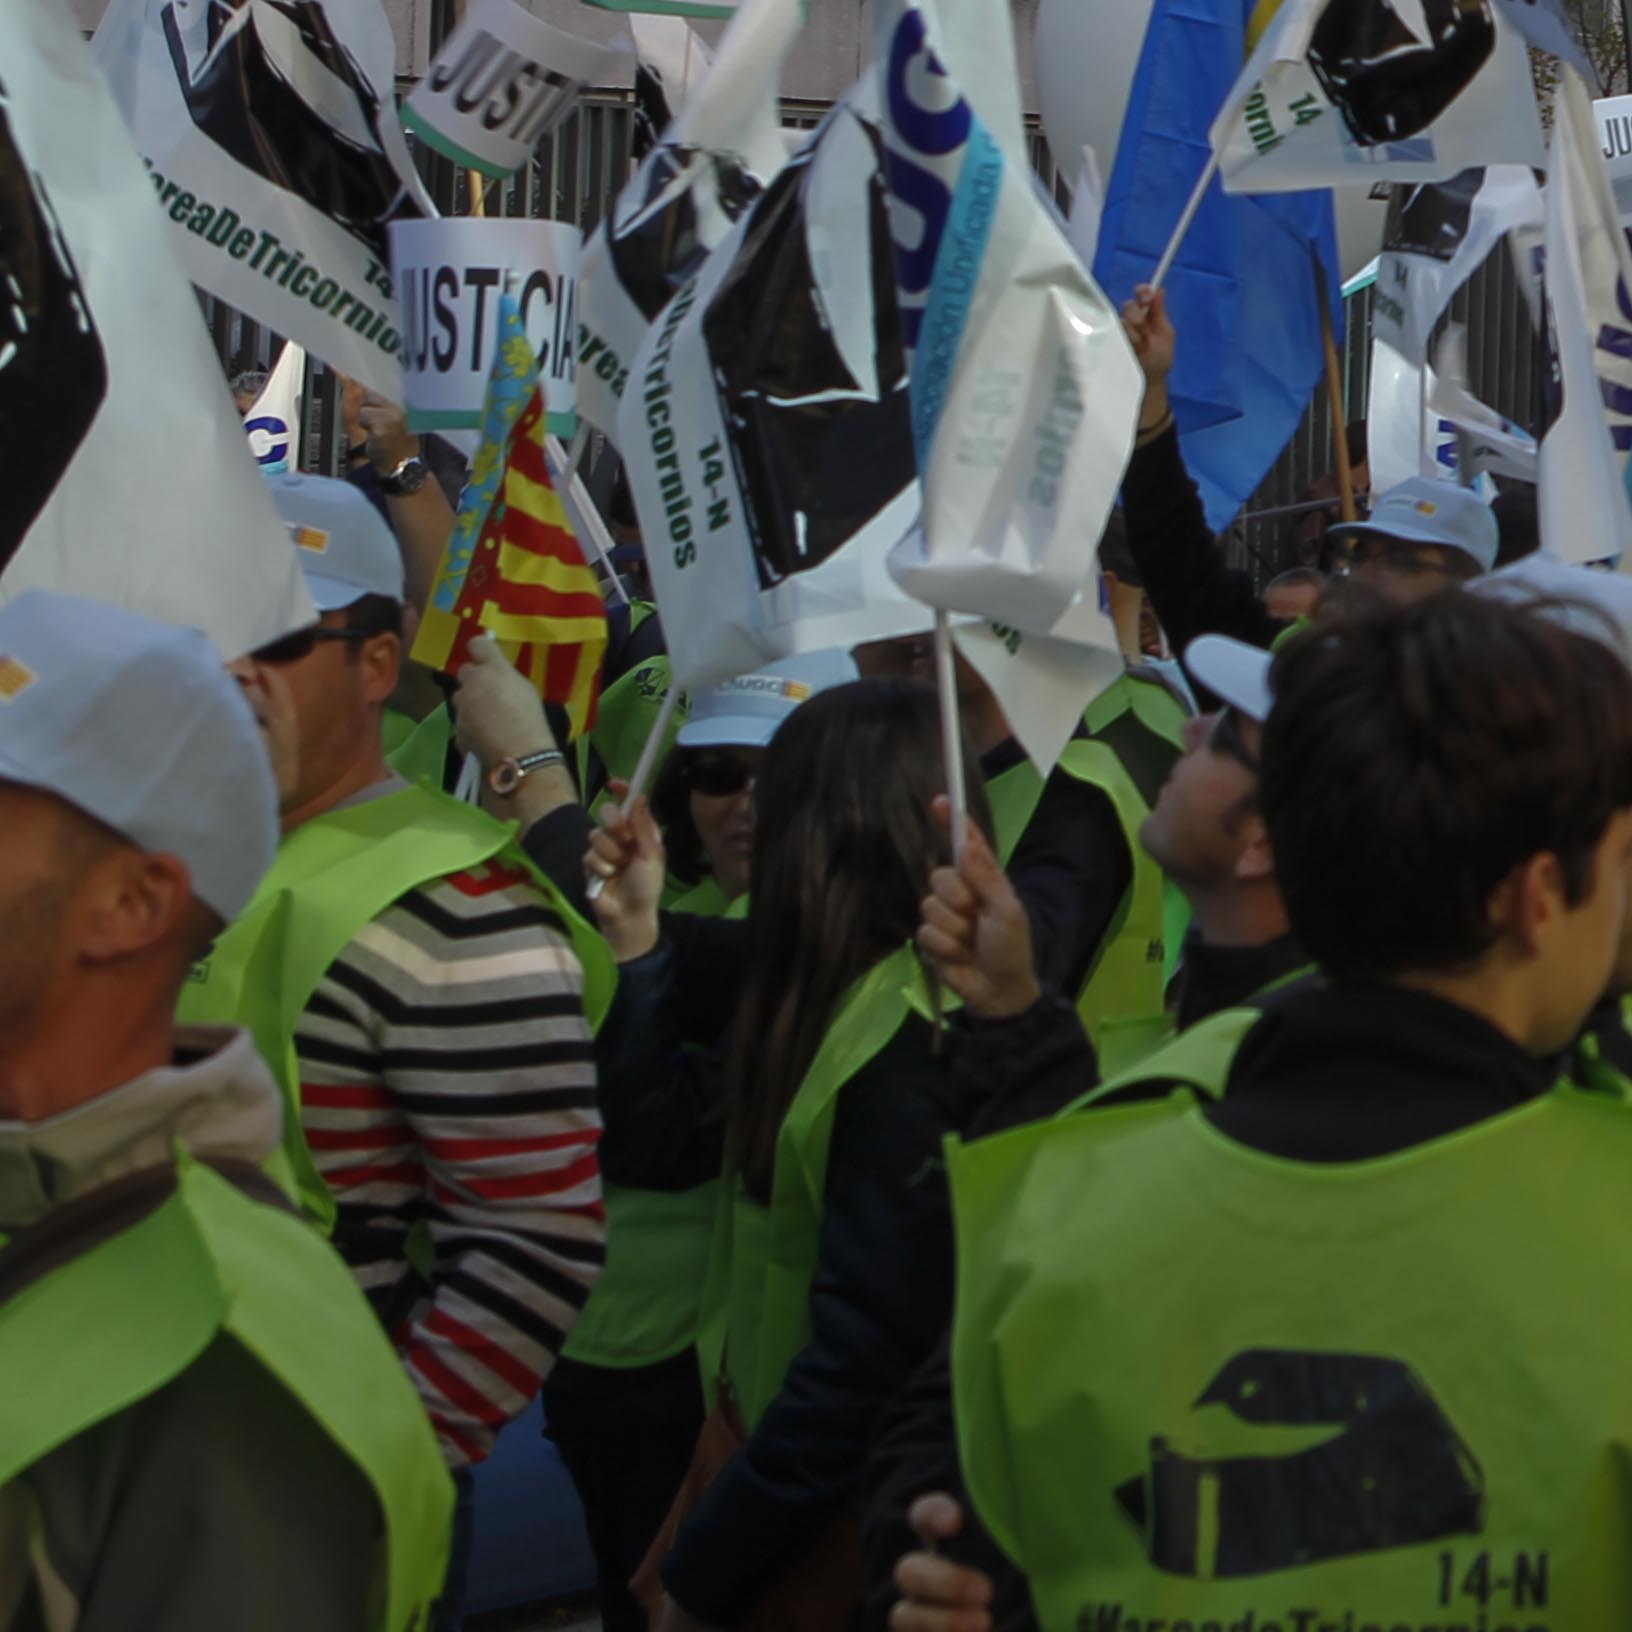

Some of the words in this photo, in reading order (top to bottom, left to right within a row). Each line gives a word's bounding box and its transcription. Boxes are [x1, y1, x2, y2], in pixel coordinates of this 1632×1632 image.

[145, 156, 412, 366] reaDeTricornio
[699, 434, 731, 533] 14-N
[1437, 1550, 1549, 1608] 14-N
